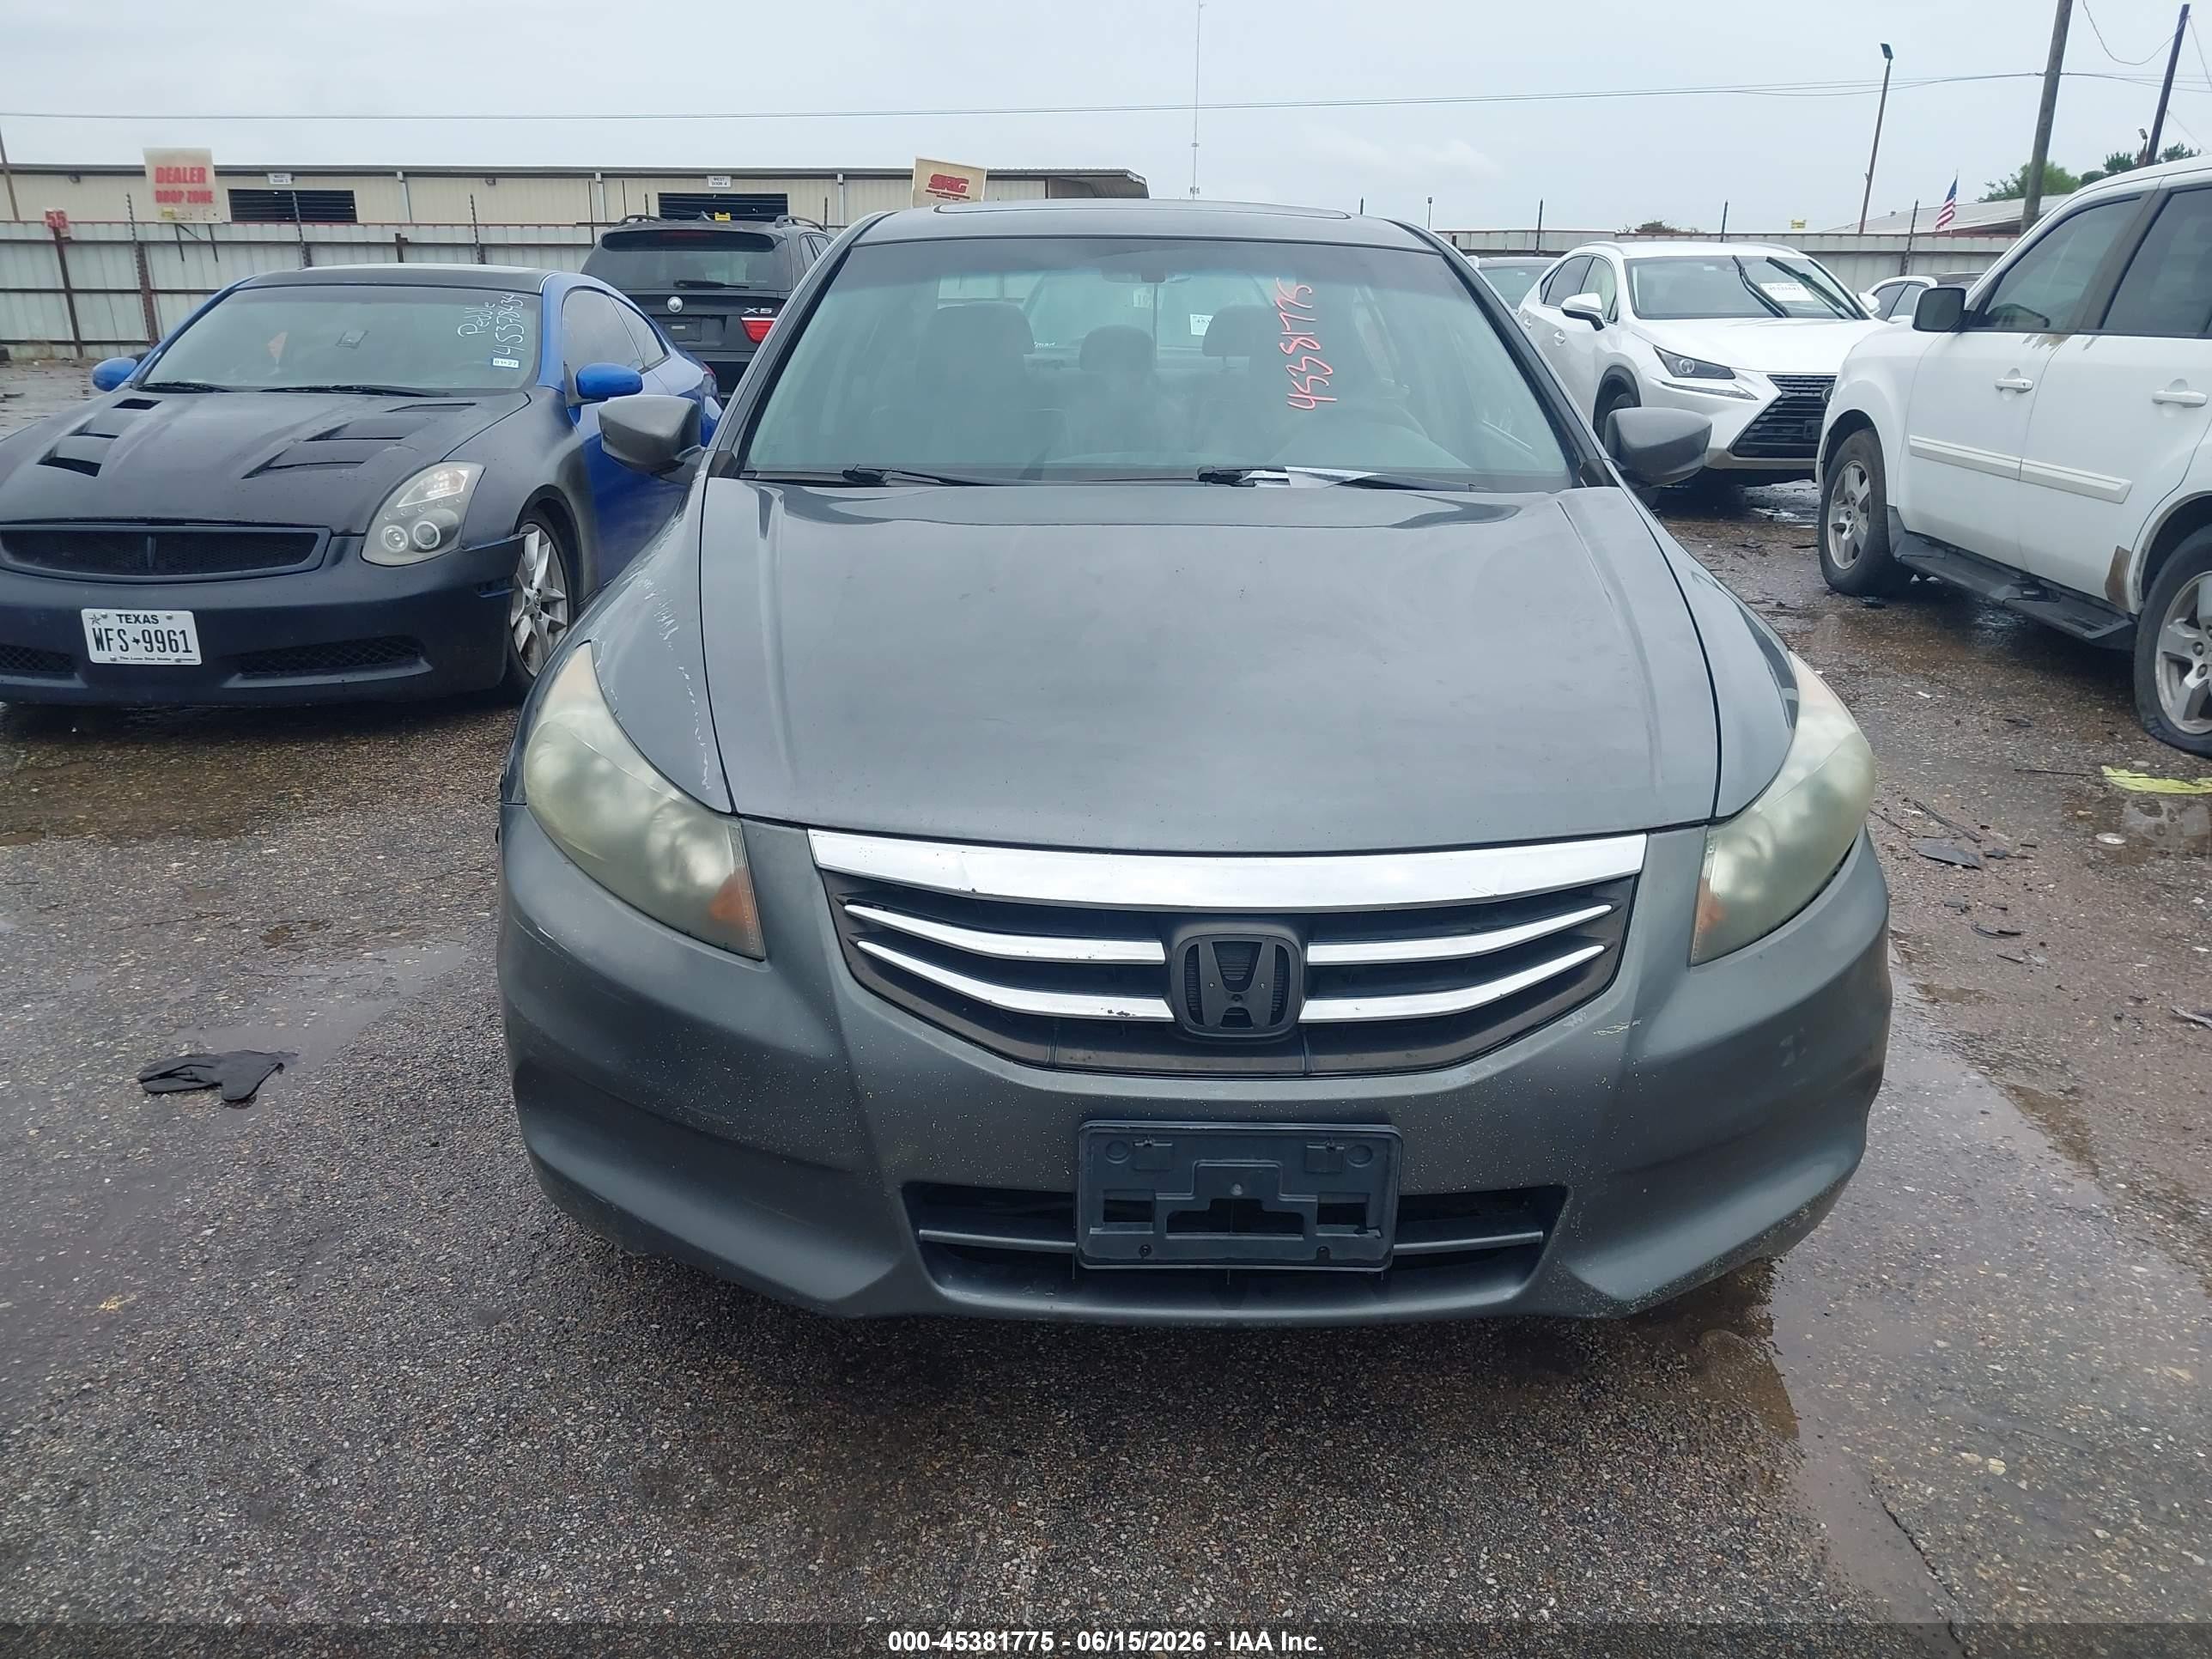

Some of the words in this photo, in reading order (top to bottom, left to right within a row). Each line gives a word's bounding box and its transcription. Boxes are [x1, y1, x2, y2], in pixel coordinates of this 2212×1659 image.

[155, 167, 206, 184] DEALER
[927, 173, 969, 194] SRG
[155, 190, 185, 204] DROP
[186, 190, 214, 204] ZONE
[116, 613, 160, 625] TEXAS
